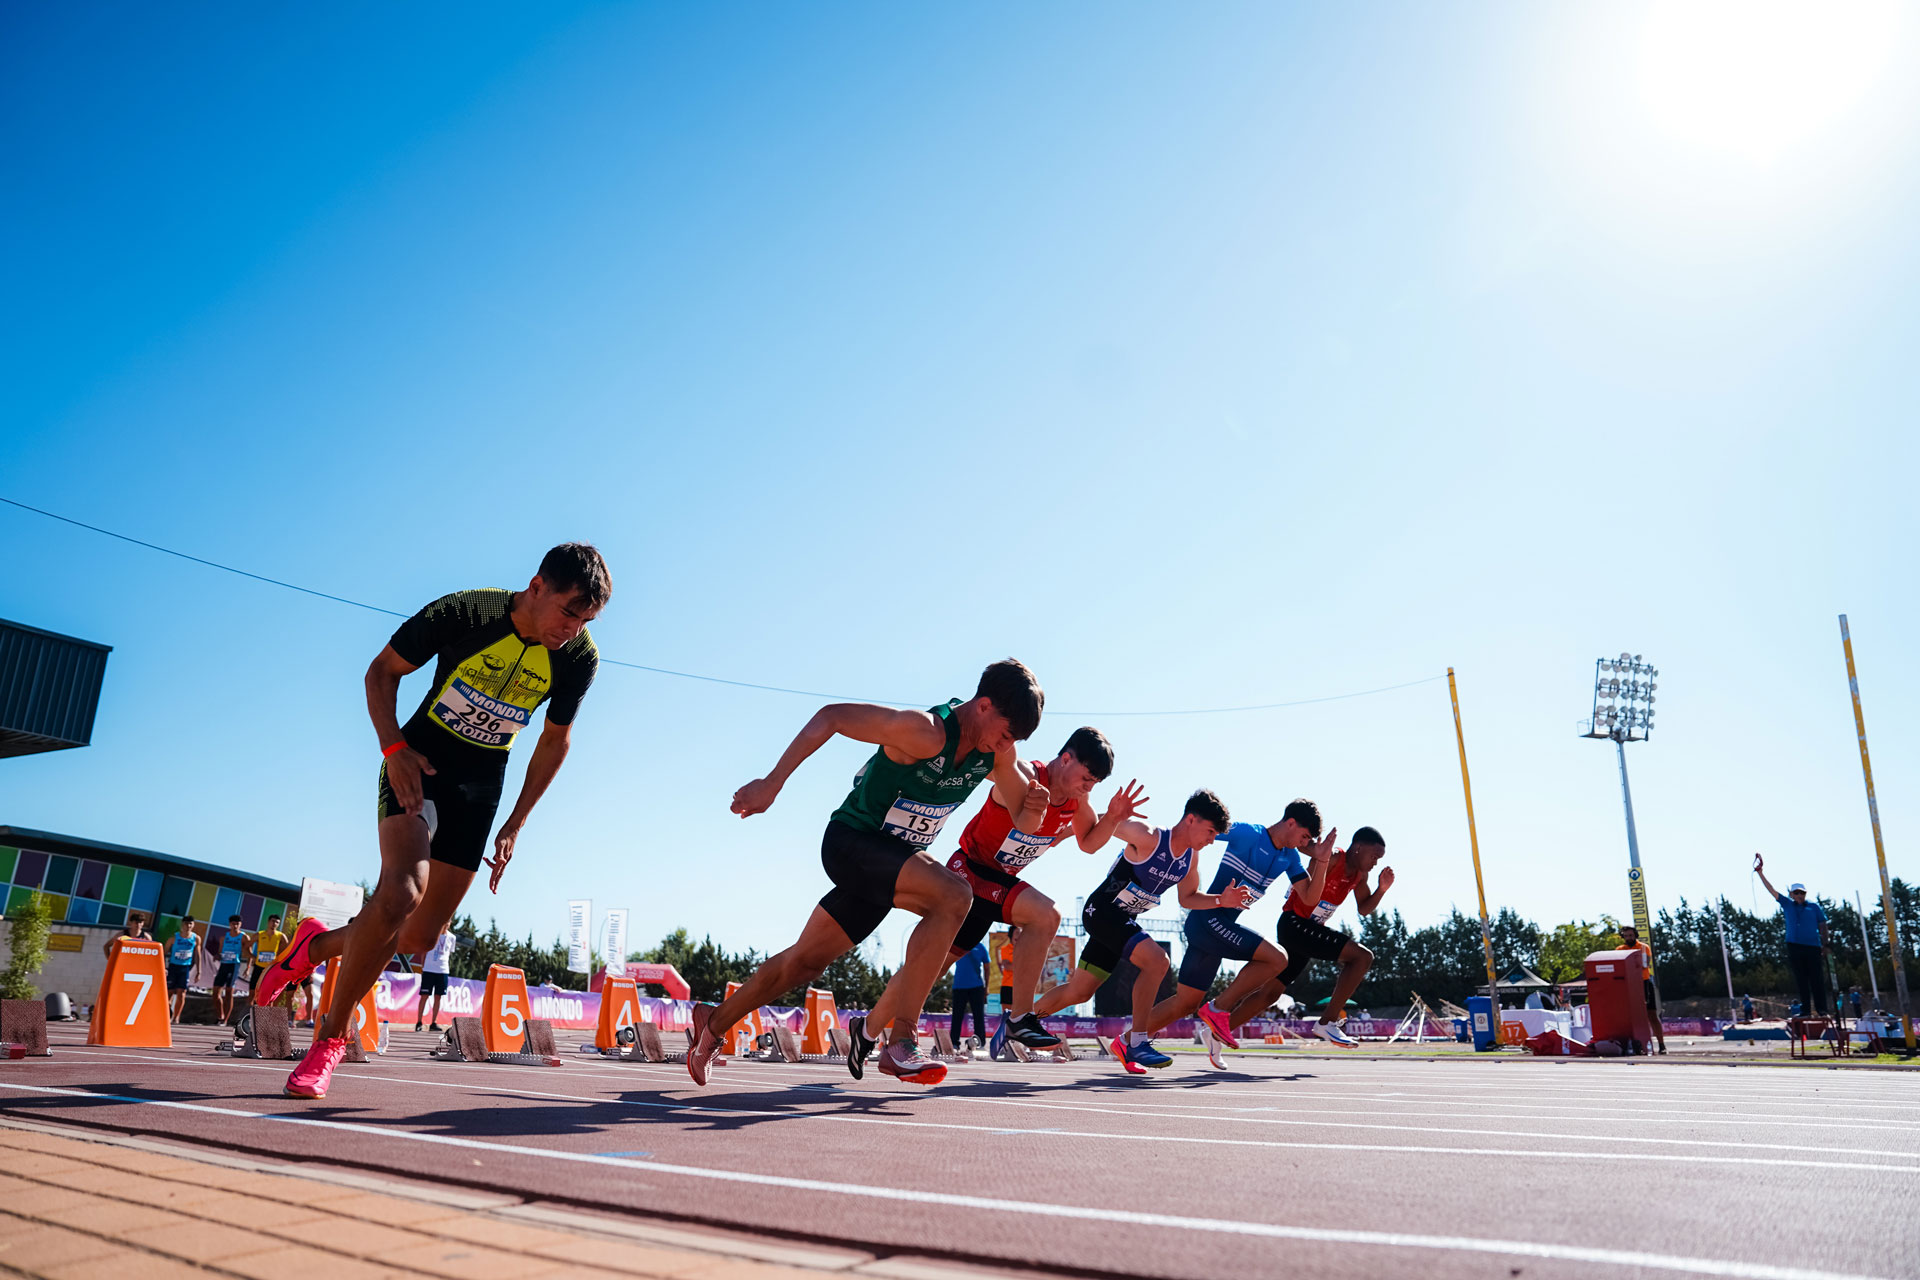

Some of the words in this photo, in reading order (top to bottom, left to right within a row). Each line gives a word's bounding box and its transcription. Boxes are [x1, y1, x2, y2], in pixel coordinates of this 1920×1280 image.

[458, 703, 504, 732] 296
[468, 690, 525, 721] MONDO
[908, 814, 940, 833] 151
[1014, 844, 1040, 857] 468
[1630, 881, 1646, 915] CENTRO
[1207, 917, 1243, 946] SABADELL
[1635, 918, 1646, 932] DEL
[121, 946, 159, 956] MONDO
[123, 973, 153, 1025] 7
[541, 997, 584, 1021] MONDO
[500, 994, 524, 1037] 5
[615, 1000, 633, 1031] 4
[743, 1011, 757, 1042] 3
[821, 1010, 834, 1042] 2
[1506, 1026, 1521, 1039] 17
